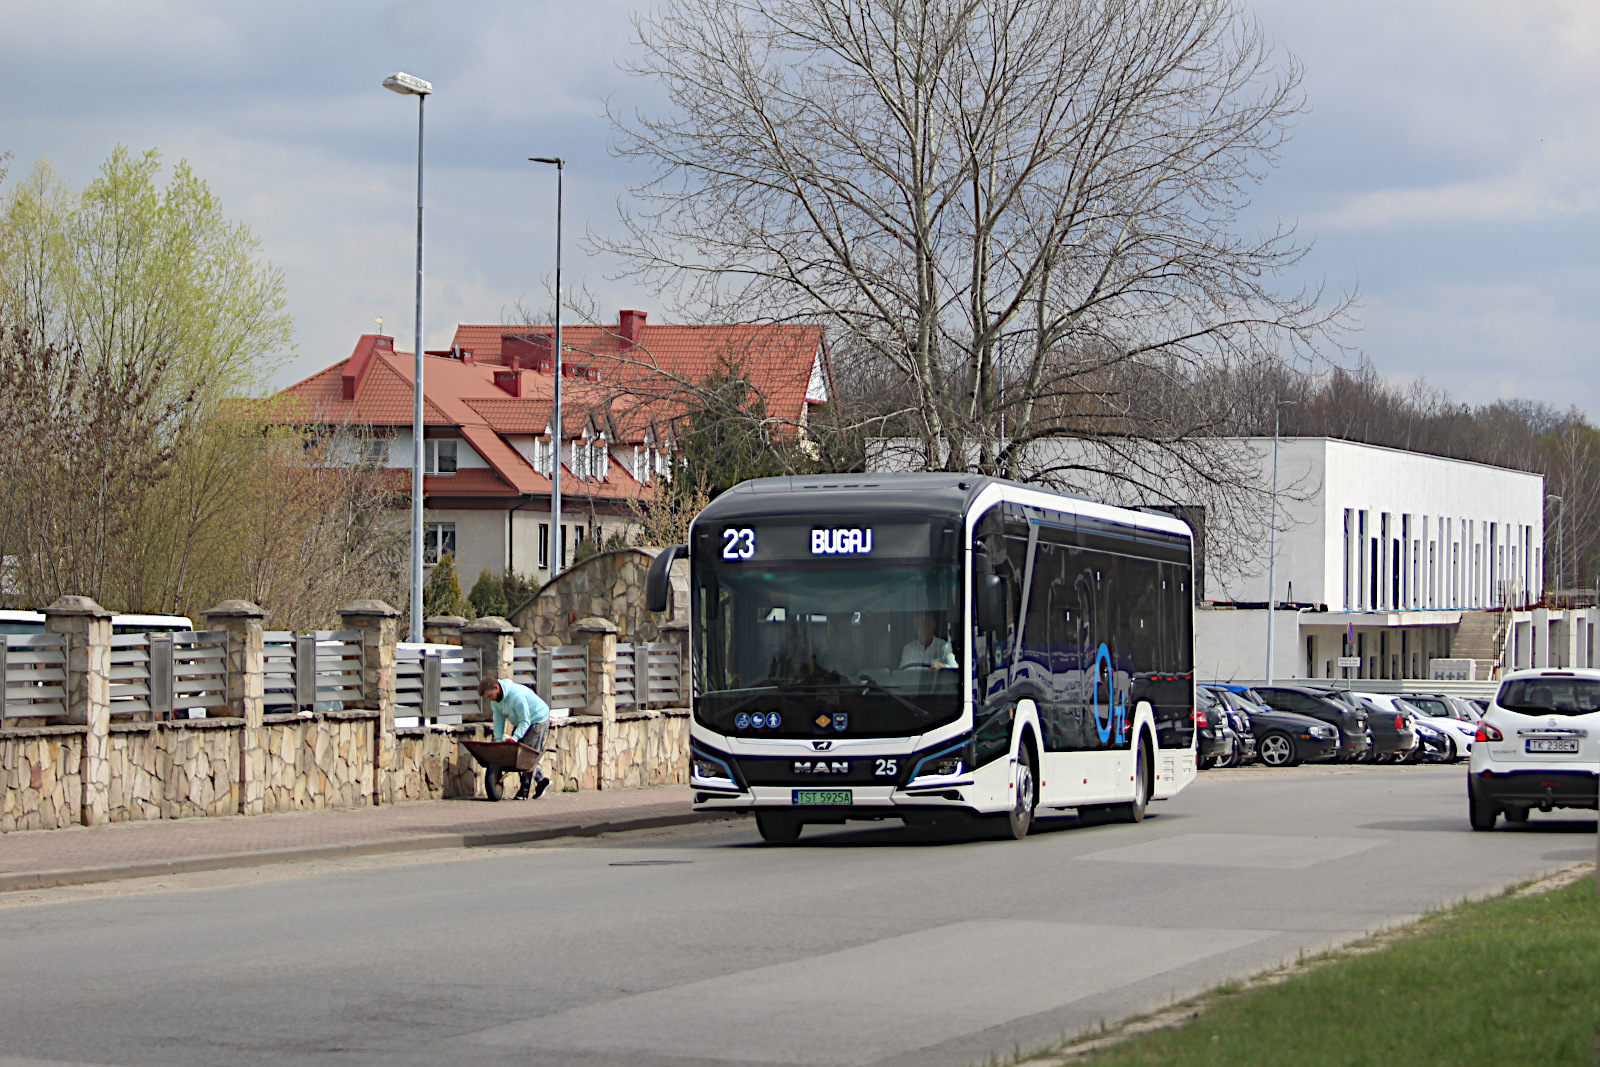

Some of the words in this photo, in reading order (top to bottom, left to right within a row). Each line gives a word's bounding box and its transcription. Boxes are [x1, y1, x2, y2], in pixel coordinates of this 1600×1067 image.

[723, 528, 755, 559] 23
[811, 528, 872, 554] BUGAJ
[1532, 740, 1543, 750] TK
[794, 761, 849, 774] MAN
[874, 758, 898, 776] 25
[798, 792, 817, 803] TST
[820, 792, 850, 803] 5925A
